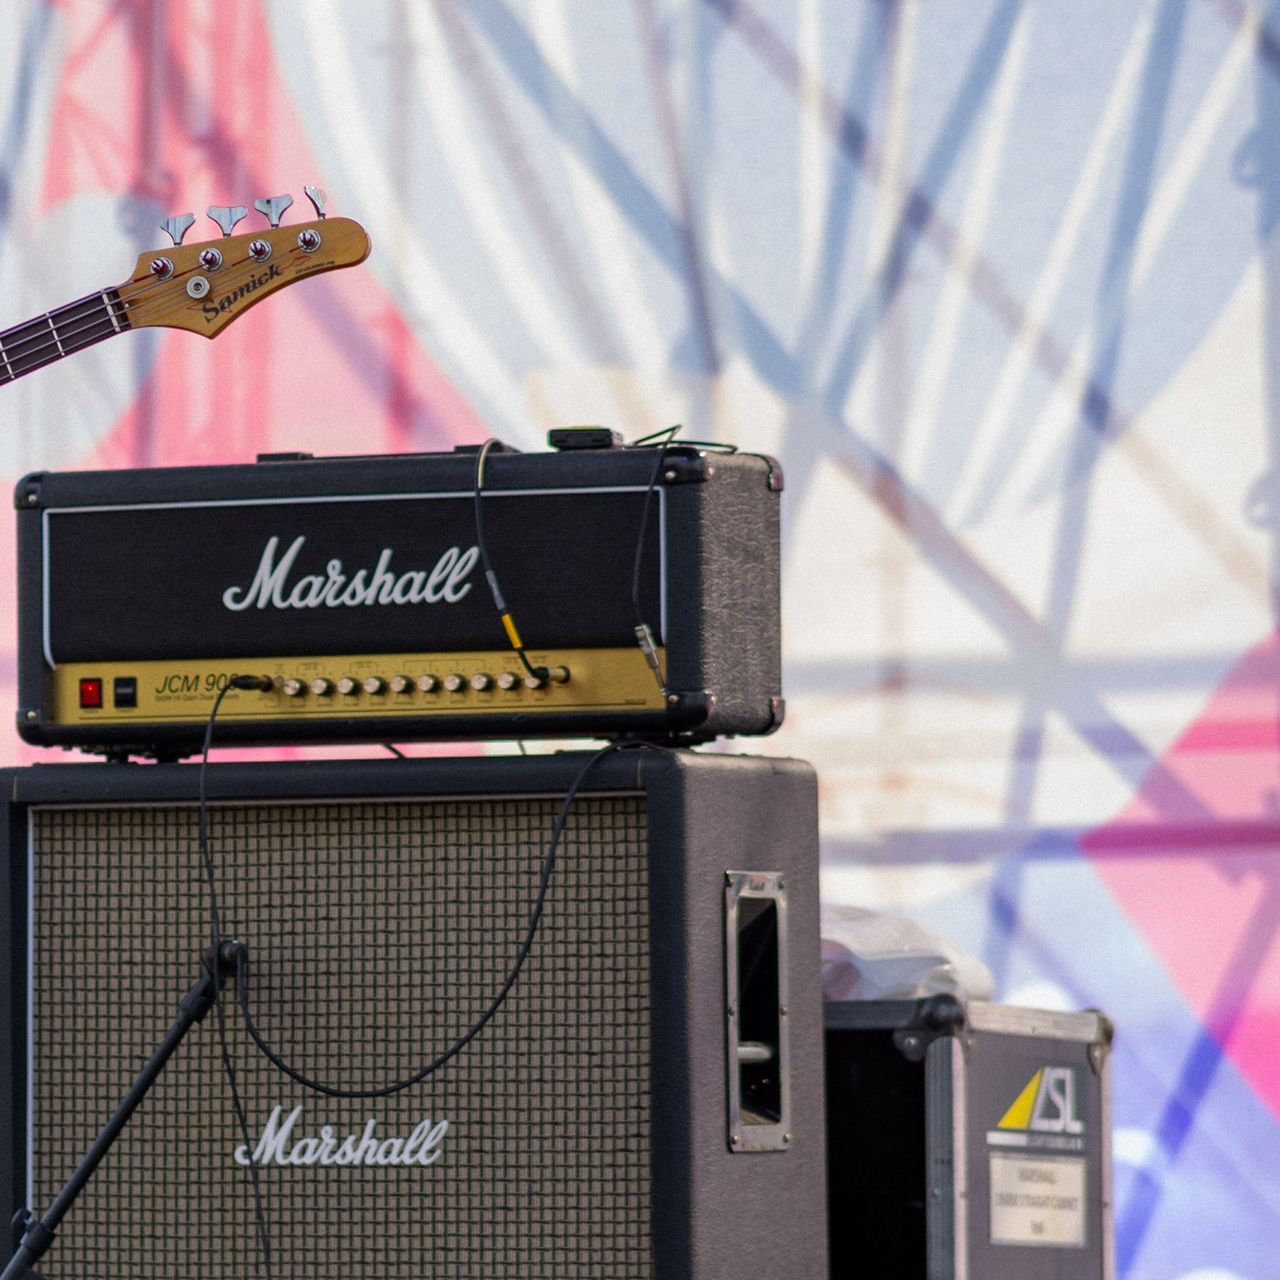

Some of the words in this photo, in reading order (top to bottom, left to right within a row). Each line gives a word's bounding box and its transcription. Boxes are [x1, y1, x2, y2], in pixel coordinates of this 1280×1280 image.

[201, 263, 283, 324] Samick
[222, 535, 480, 611] Marshall
[155, 674, 200, 694] JCM
[233, 1104, 450, 1166] Marshall
